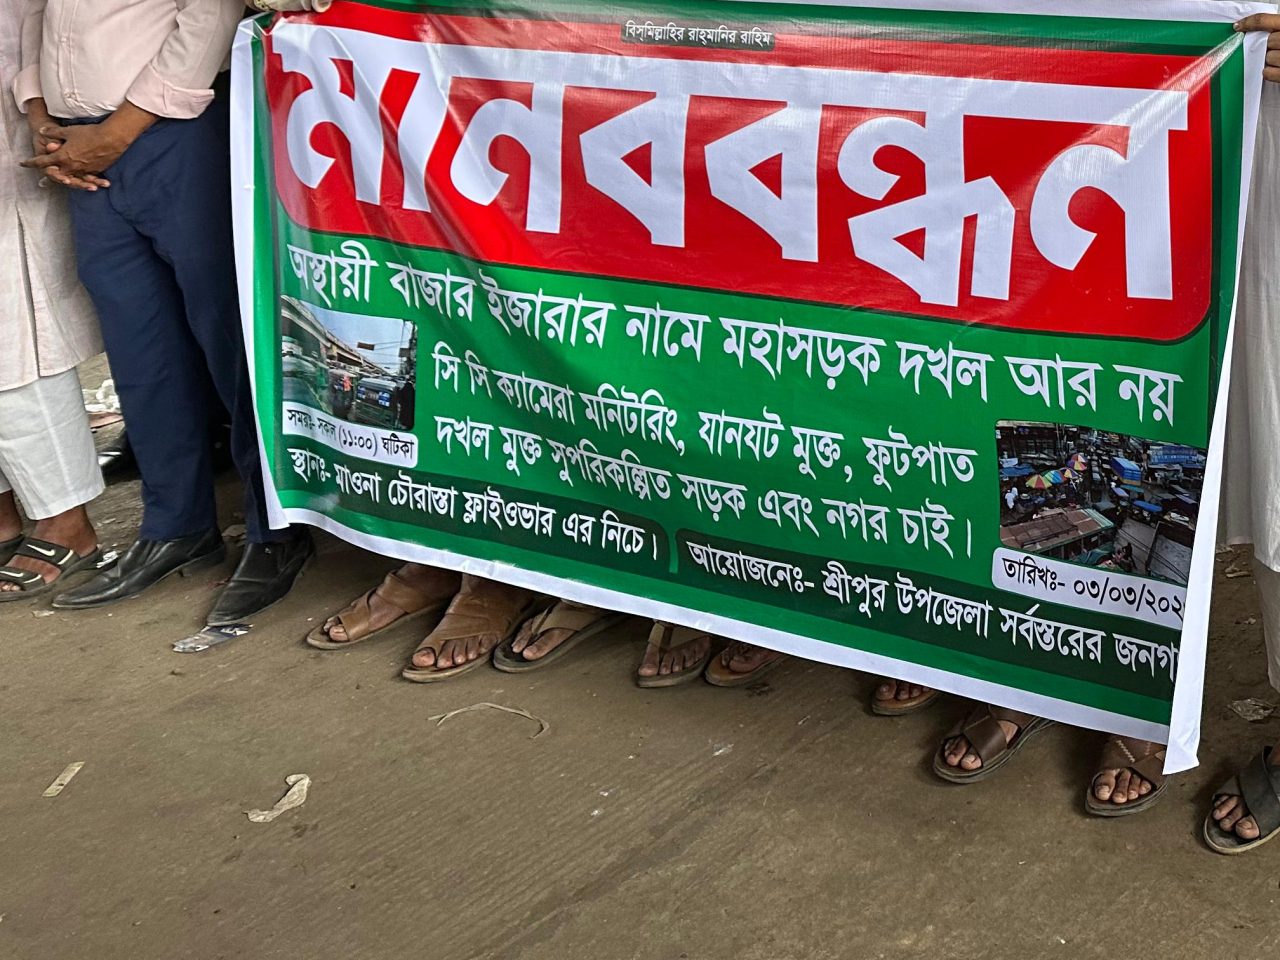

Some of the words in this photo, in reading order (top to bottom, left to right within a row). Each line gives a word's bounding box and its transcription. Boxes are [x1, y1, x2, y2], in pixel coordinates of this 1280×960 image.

[740, 27, 772, 47] রাহিম
[272, 17, 1188, 307] মানববন্ধন
[287, 240, 378, 307] অস্থায়ী
[385, 261, 477, 322] বাজার
[478, 268, 617, 349] ইজারার
[624, 301, 711, 362] নামে
[718, 317, 887, 390] মহাসড়ক
[895, 340, 995, 403] দখল
[1003, 353, 1104, 412] আর
[1112, 364, 1184, 427] নয়
[339, 424, 378, 457] (১১:০০)
[380, 433, 415, 459] ঘটিকা
[431, 341, 461, 392] সি
[464, 349, 492, 399] সি
[491, 369, 575, 425] ক্যামেরা
[578, 383, 685, 457] মনিটরিং,
[698, 406, 785, 462] যানযট
[861, 425, 979, 492] ফুটপাত
[333, 463, 383, 503] মাওনা
[388, 469, 459, 519] চৌরাস্তা
[461, 484, 556, 538] ফ্লাইওভার
[561, 512, 596, 546] এর
[433, 414, 494, 460] দখল
[498, 424, 543, 477] মুক্ত
[550, 438, 673, 501] সুপরিকল্পিত
[676, 472, 748, 522] সড়ক
[757, 489, 820, 538] এবং
[820, 497, 891, 544] নগর
[820, 561, 889, 618] শ্রীপুর
[895, 572, 994, 639] উপজেলা
[998, 603, 1106, 664] সর্বস্তরের
[1112, 632, 1180, 683] জনগ
[1073, 576, 1185, 623] ০৩/০৩/২০২
